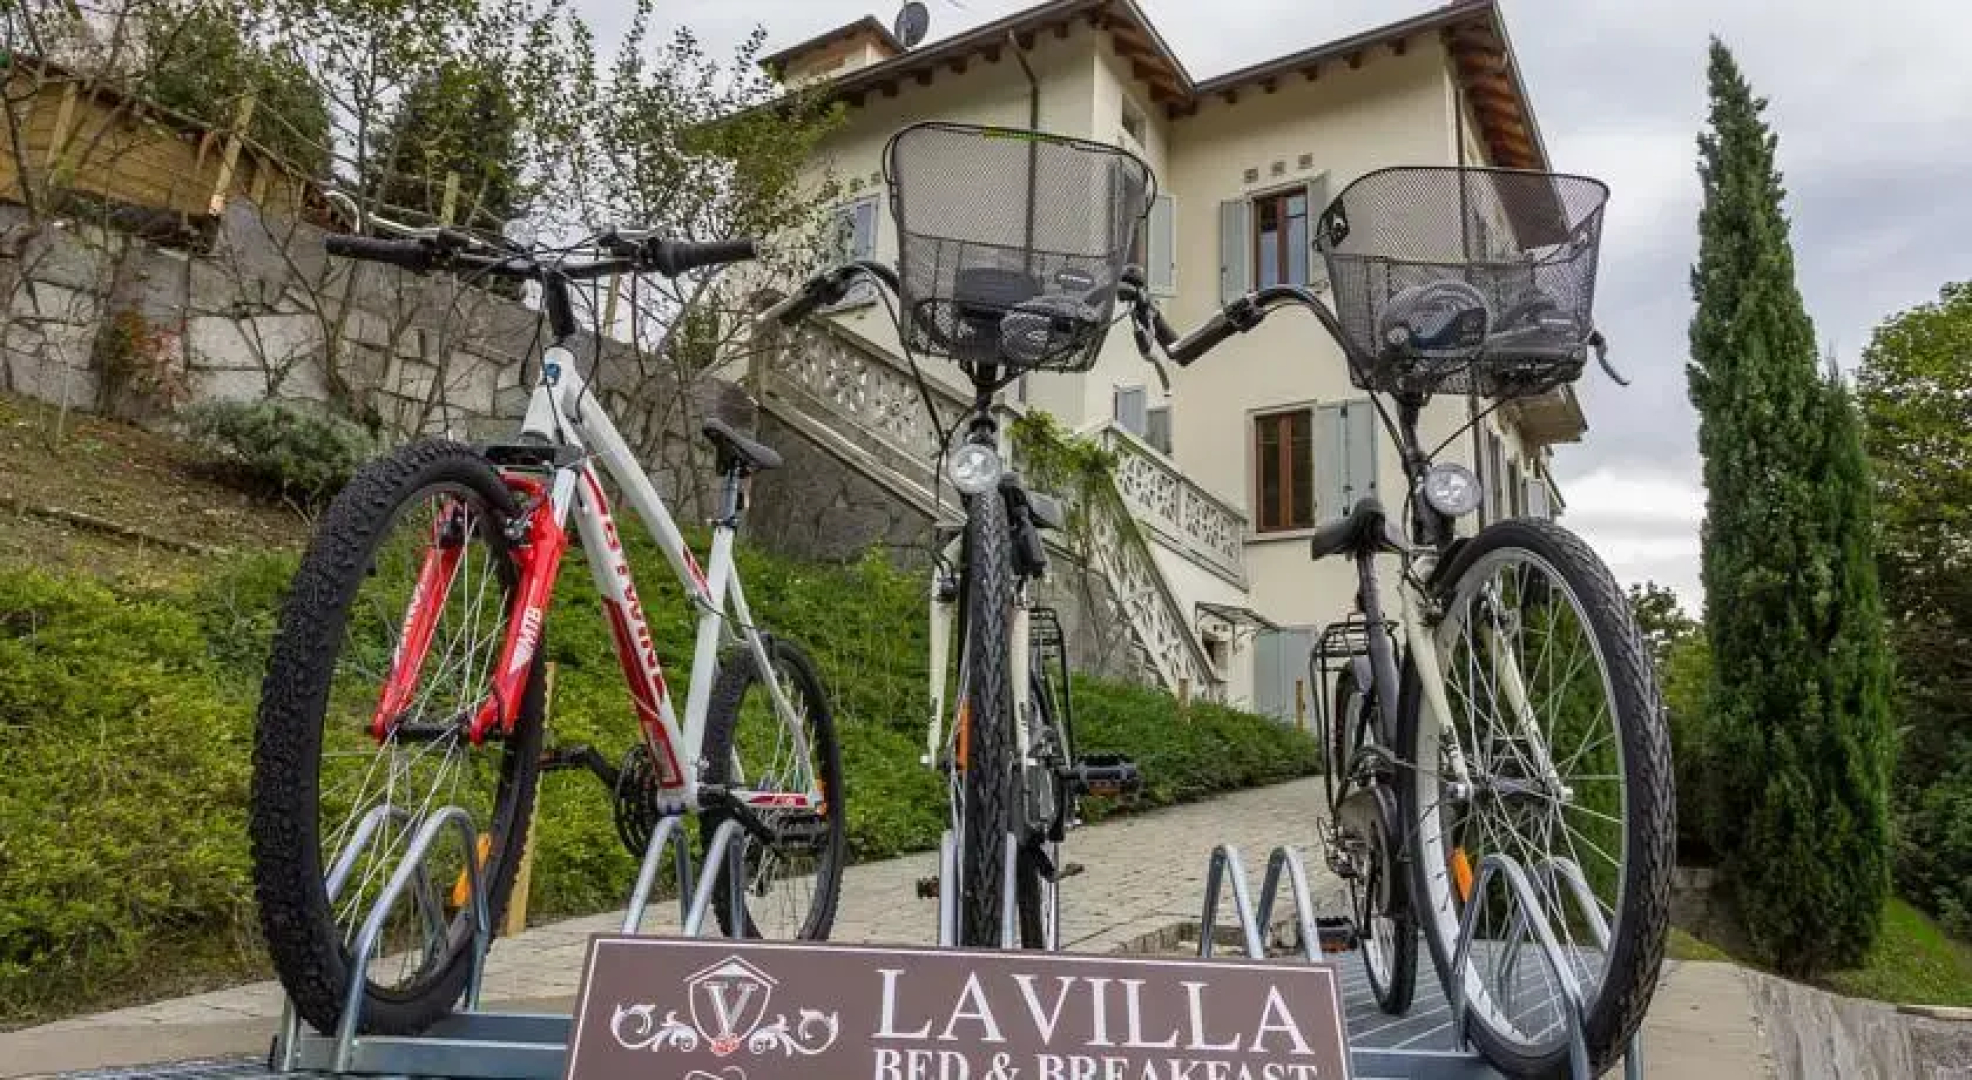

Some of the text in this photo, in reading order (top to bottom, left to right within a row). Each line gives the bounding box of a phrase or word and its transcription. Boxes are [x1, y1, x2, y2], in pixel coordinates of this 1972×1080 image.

[704, 980, 759, 1036] V
[874, 1048, 970, 1080] BED
[984, 1051, 1021, 1080] &
